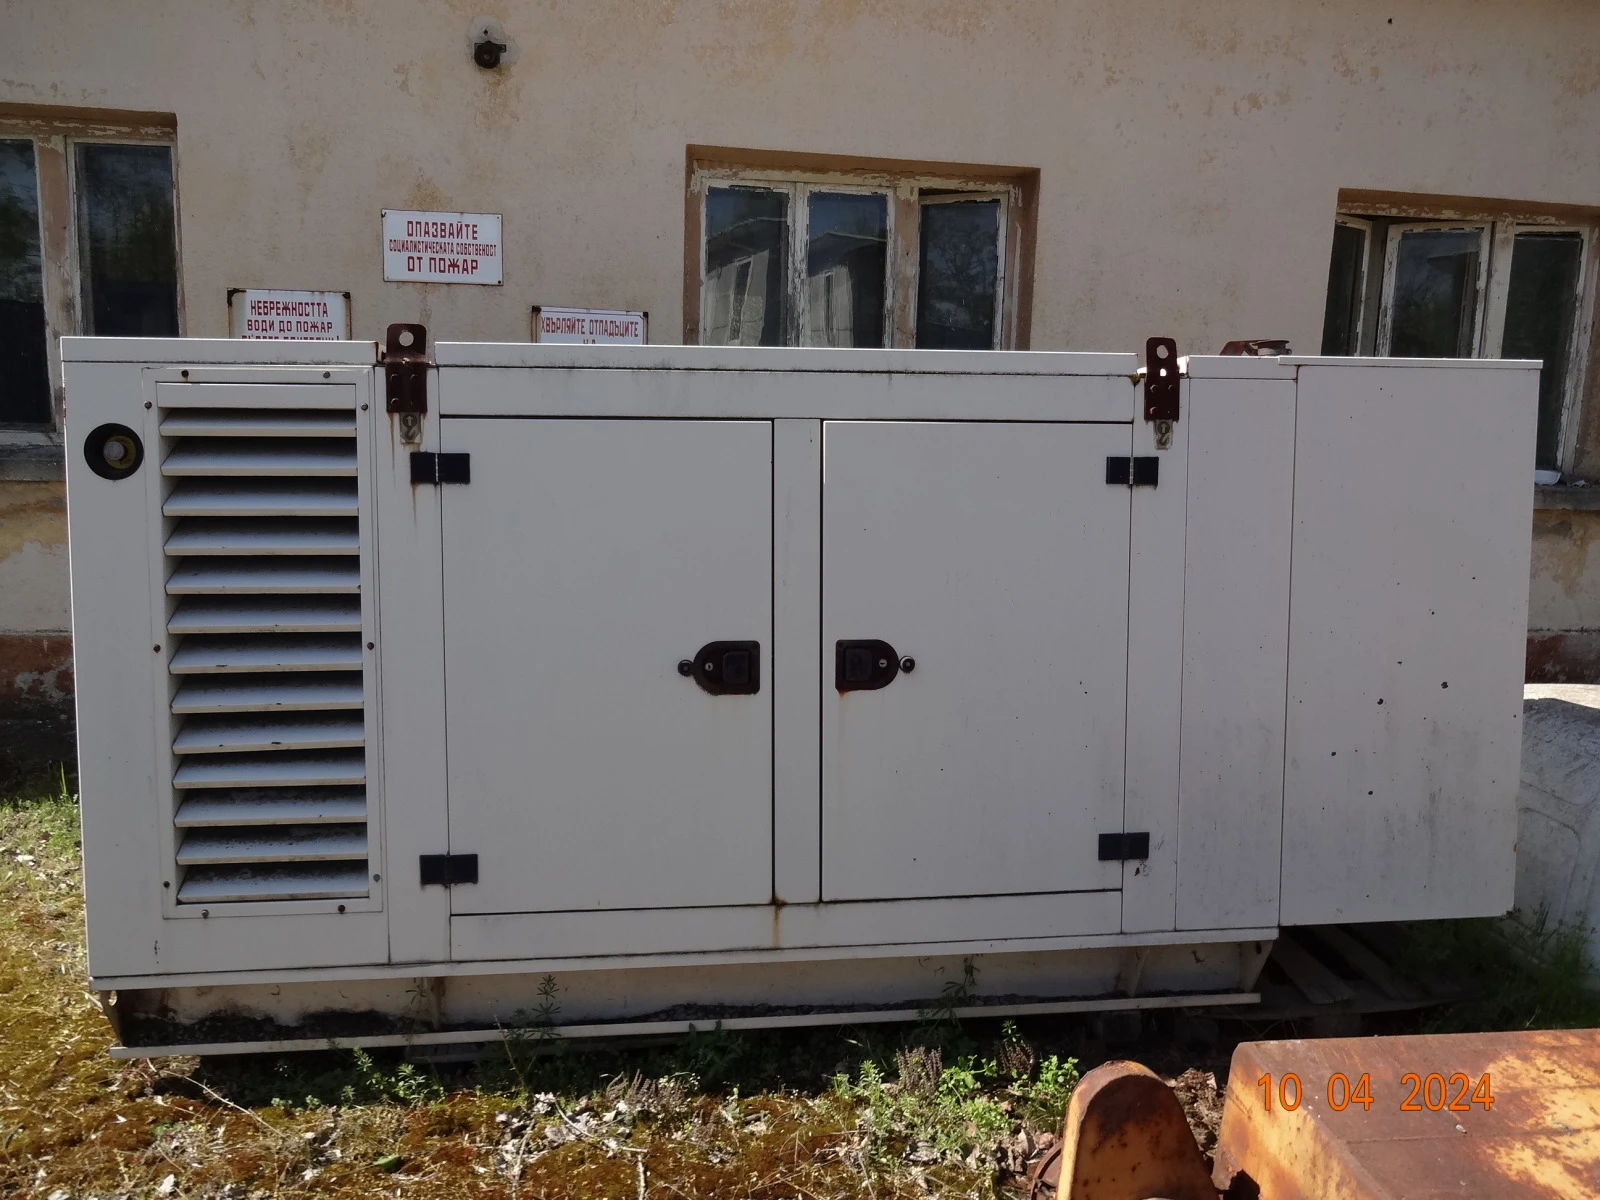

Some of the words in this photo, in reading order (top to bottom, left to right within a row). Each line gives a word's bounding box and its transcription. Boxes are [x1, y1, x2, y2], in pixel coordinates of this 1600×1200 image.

[407, 220, 478, 240] ОПАЗВАЙТЕ
[389, 239, 454, 255] СОЦИАЛИСТИЧЕСКАТА
[456, 242, 497, 257] СОБСТВЕНОСТ
[407, 256, 423, 272] ОТ
[429, 257, 478, 275] ПОЖАР
[250, 300, 329, 318] НЕБРЕЖНОСТТА
[247, 319, 275, 333] ВОДИ
[279, 320, 292, 333] ДО
[296, 321, 333, 333] ПОЖАР
[540, 316, 586, 335] ХВЪРЛЯЙТЕ
[589, 318, 639, 338] ОТПАДЪЦИТЕ
